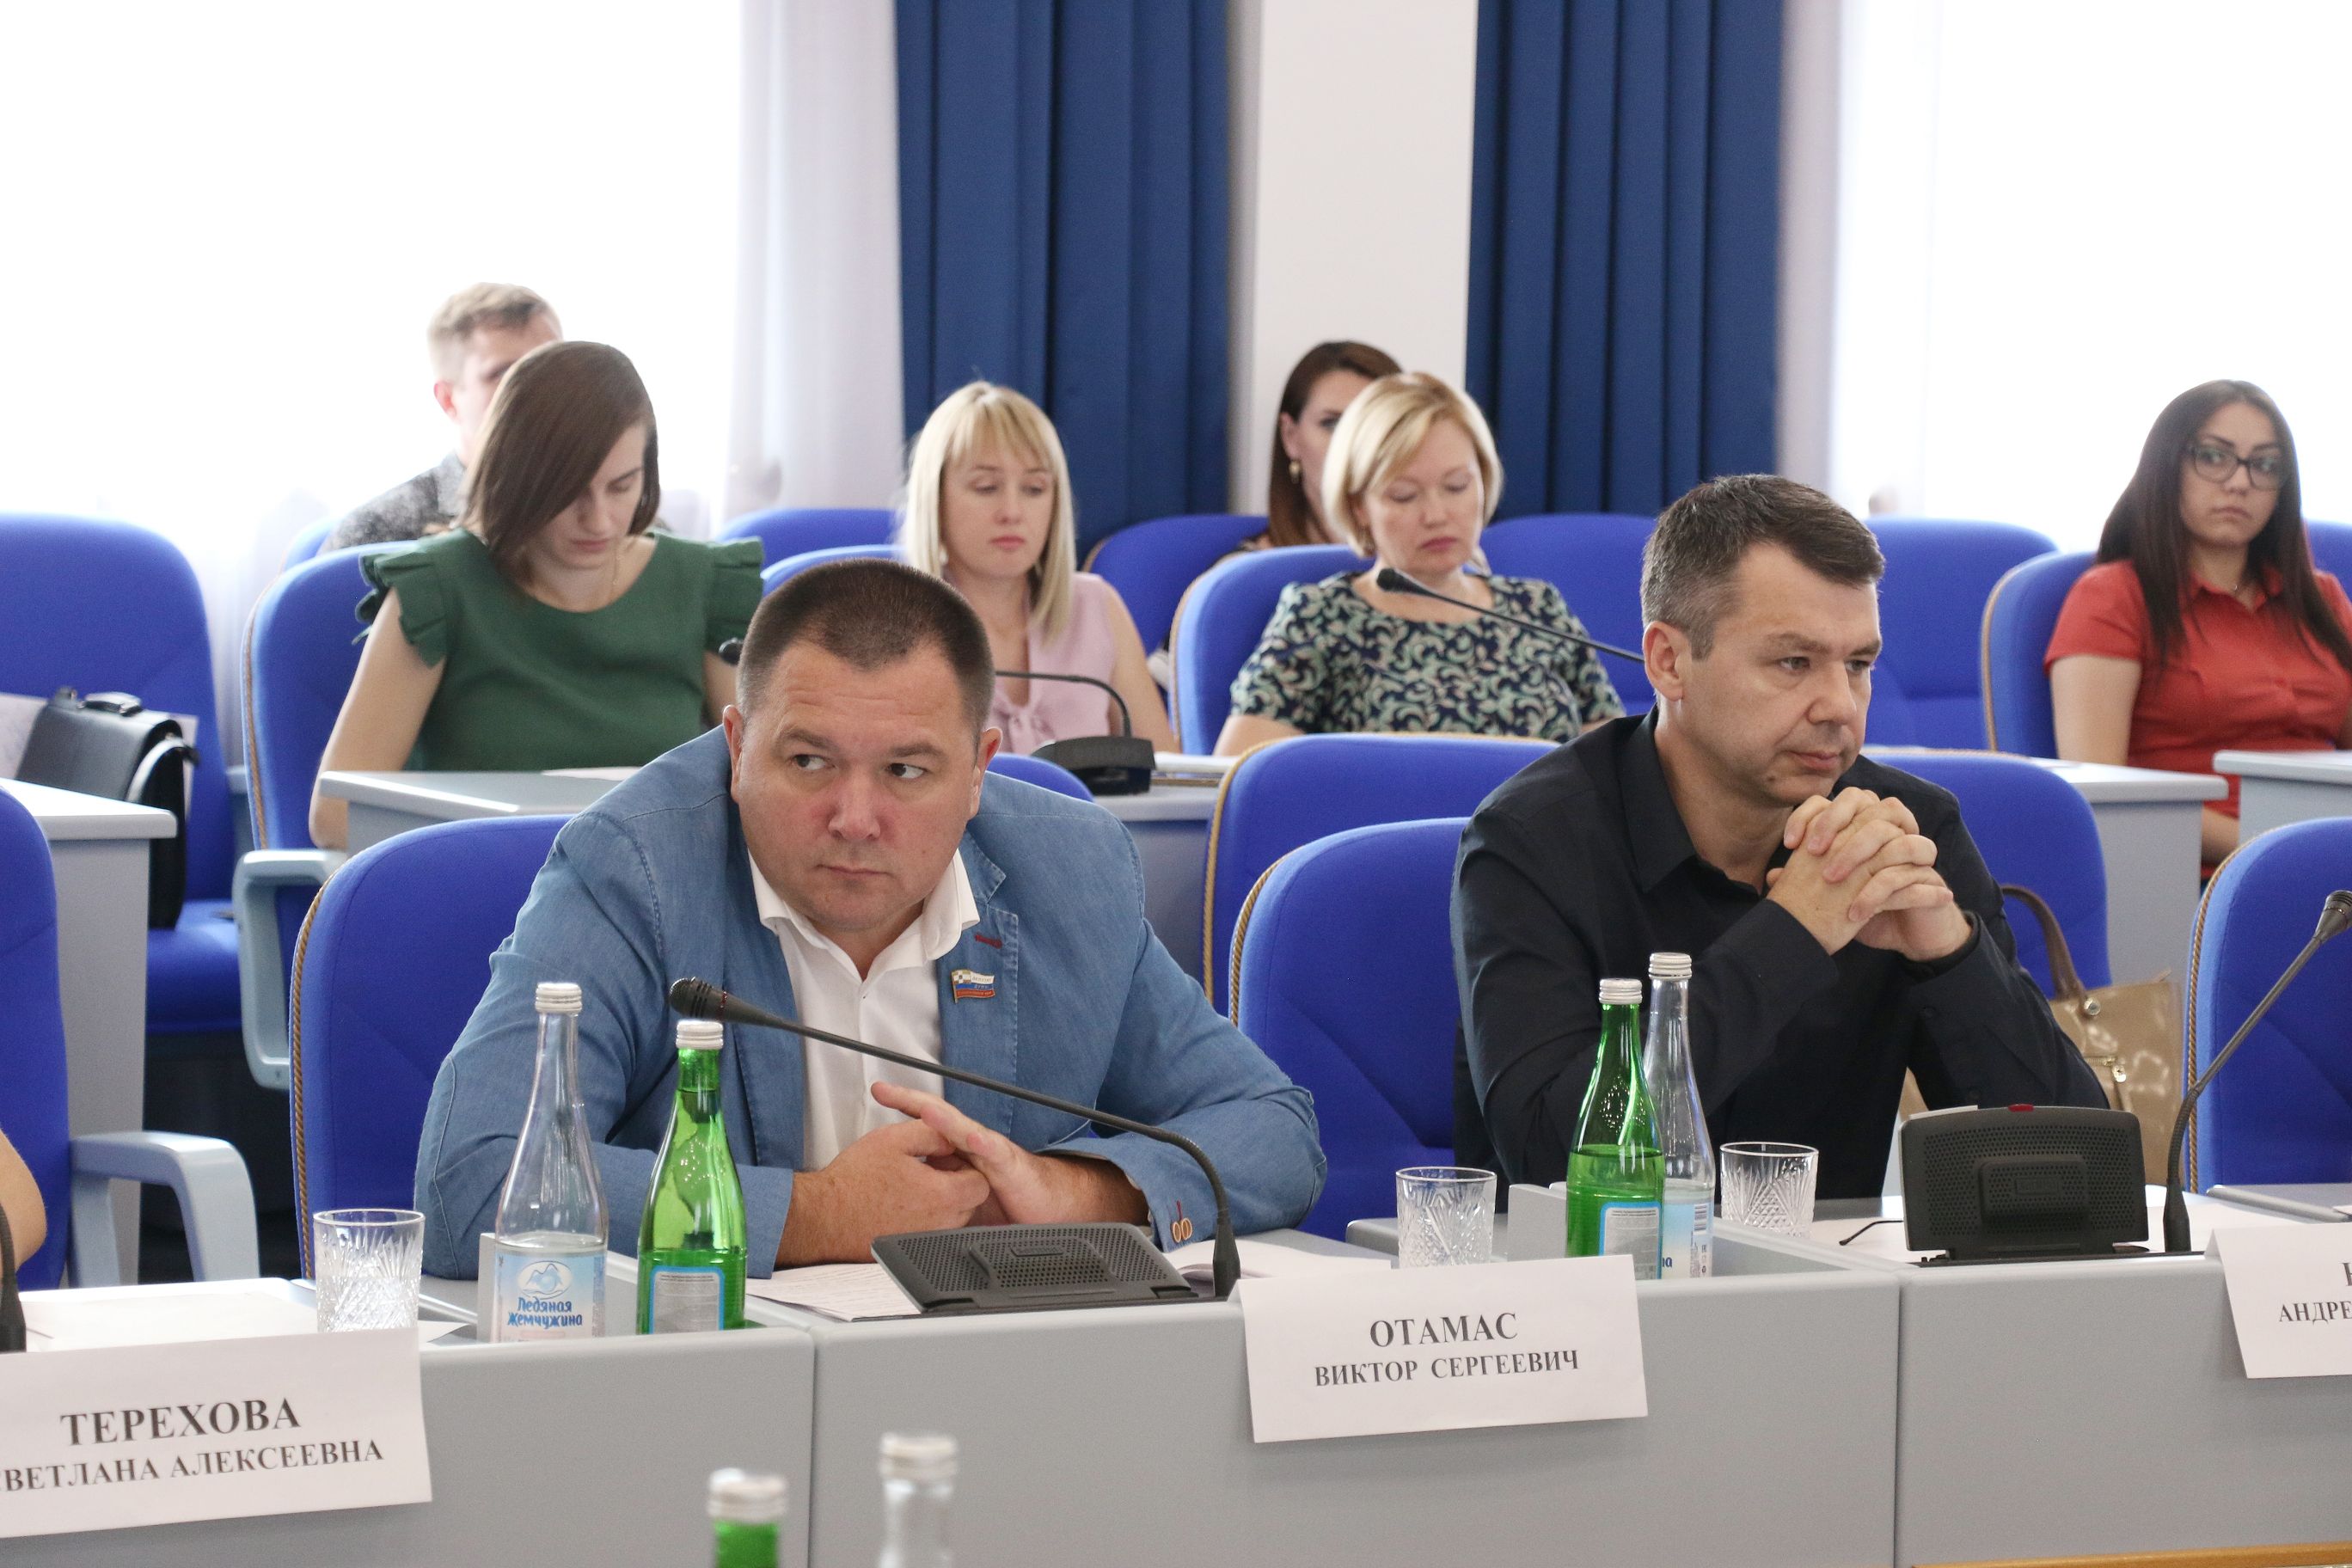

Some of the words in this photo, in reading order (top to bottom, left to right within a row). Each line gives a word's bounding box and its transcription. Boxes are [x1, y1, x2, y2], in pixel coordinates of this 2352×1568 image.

[517, 1296, 572, 1313] Ледяная
[1369, 1312, 1518, 1348] ОТАМАС
[1314, 1360, 1418, 1387] ВИКТОР
[1430, 1350, 1579, 1379] СЕРГЕЕВИЧ
[60, 1398, 301, 1446] ТЕРЕХОВА
[0, 1458, 160, 1492] ВЕТЛАНА
[170, 1440, 383, 1479] АЛЕКСЕЕВНА
